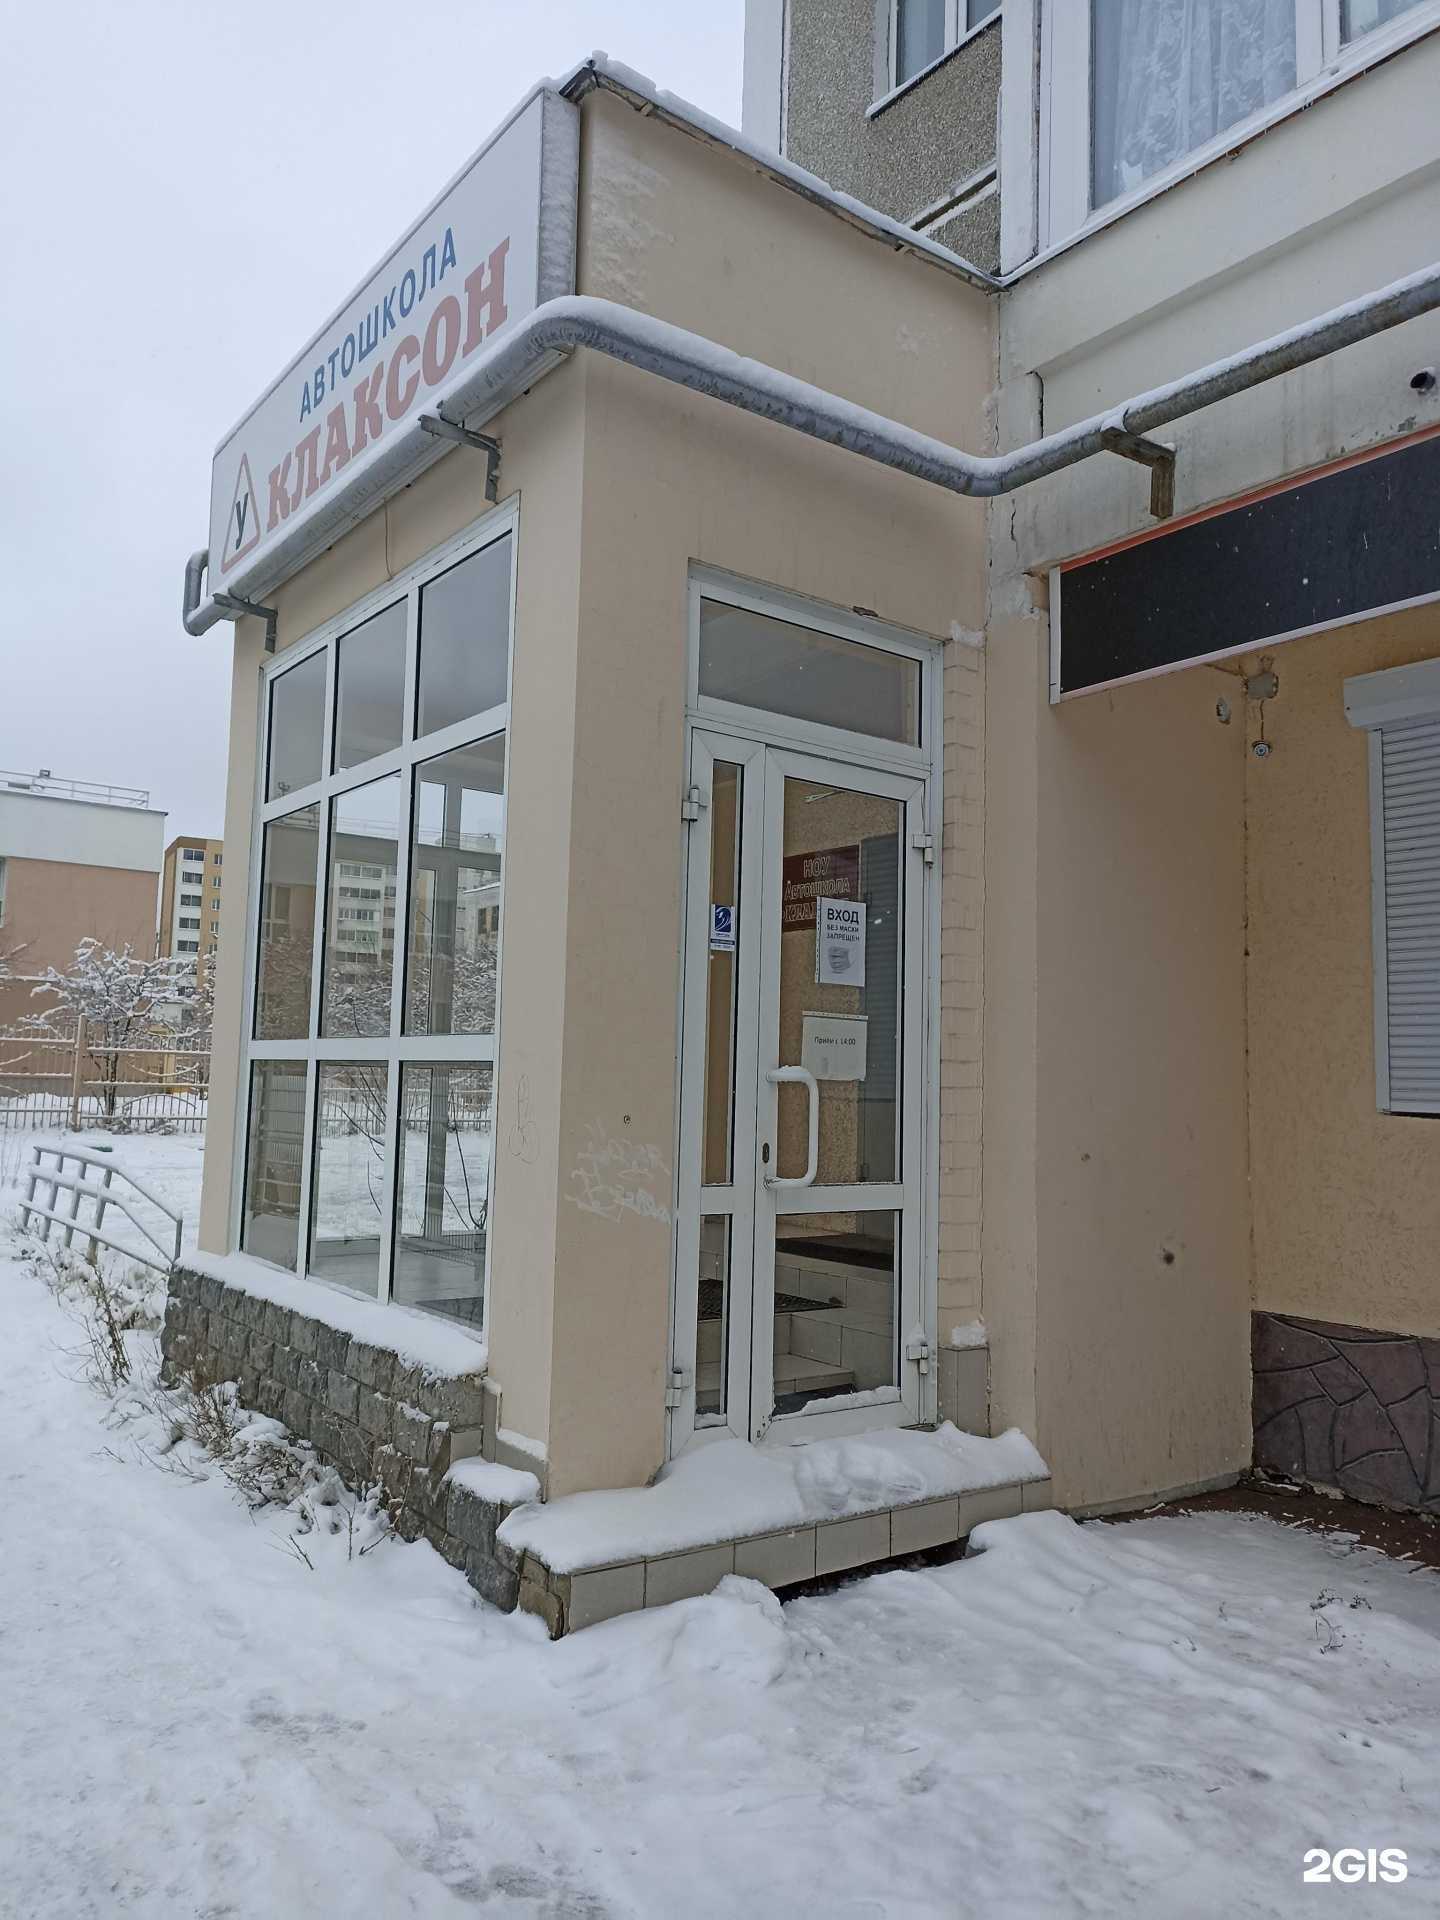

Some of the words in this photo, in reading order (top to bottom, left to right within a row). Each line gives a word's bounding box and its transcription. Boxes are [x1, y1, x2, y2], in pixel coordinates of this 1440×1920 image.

[299, 227, 458, 424] АВТОШКОЛА
[266, 236, 511, 534] КЛАКСОН
[803, 856, 831, 878] НОУ
[827, 908, 859, 924] ВХОД
[839, 925, 859, 933] МАСКИ
